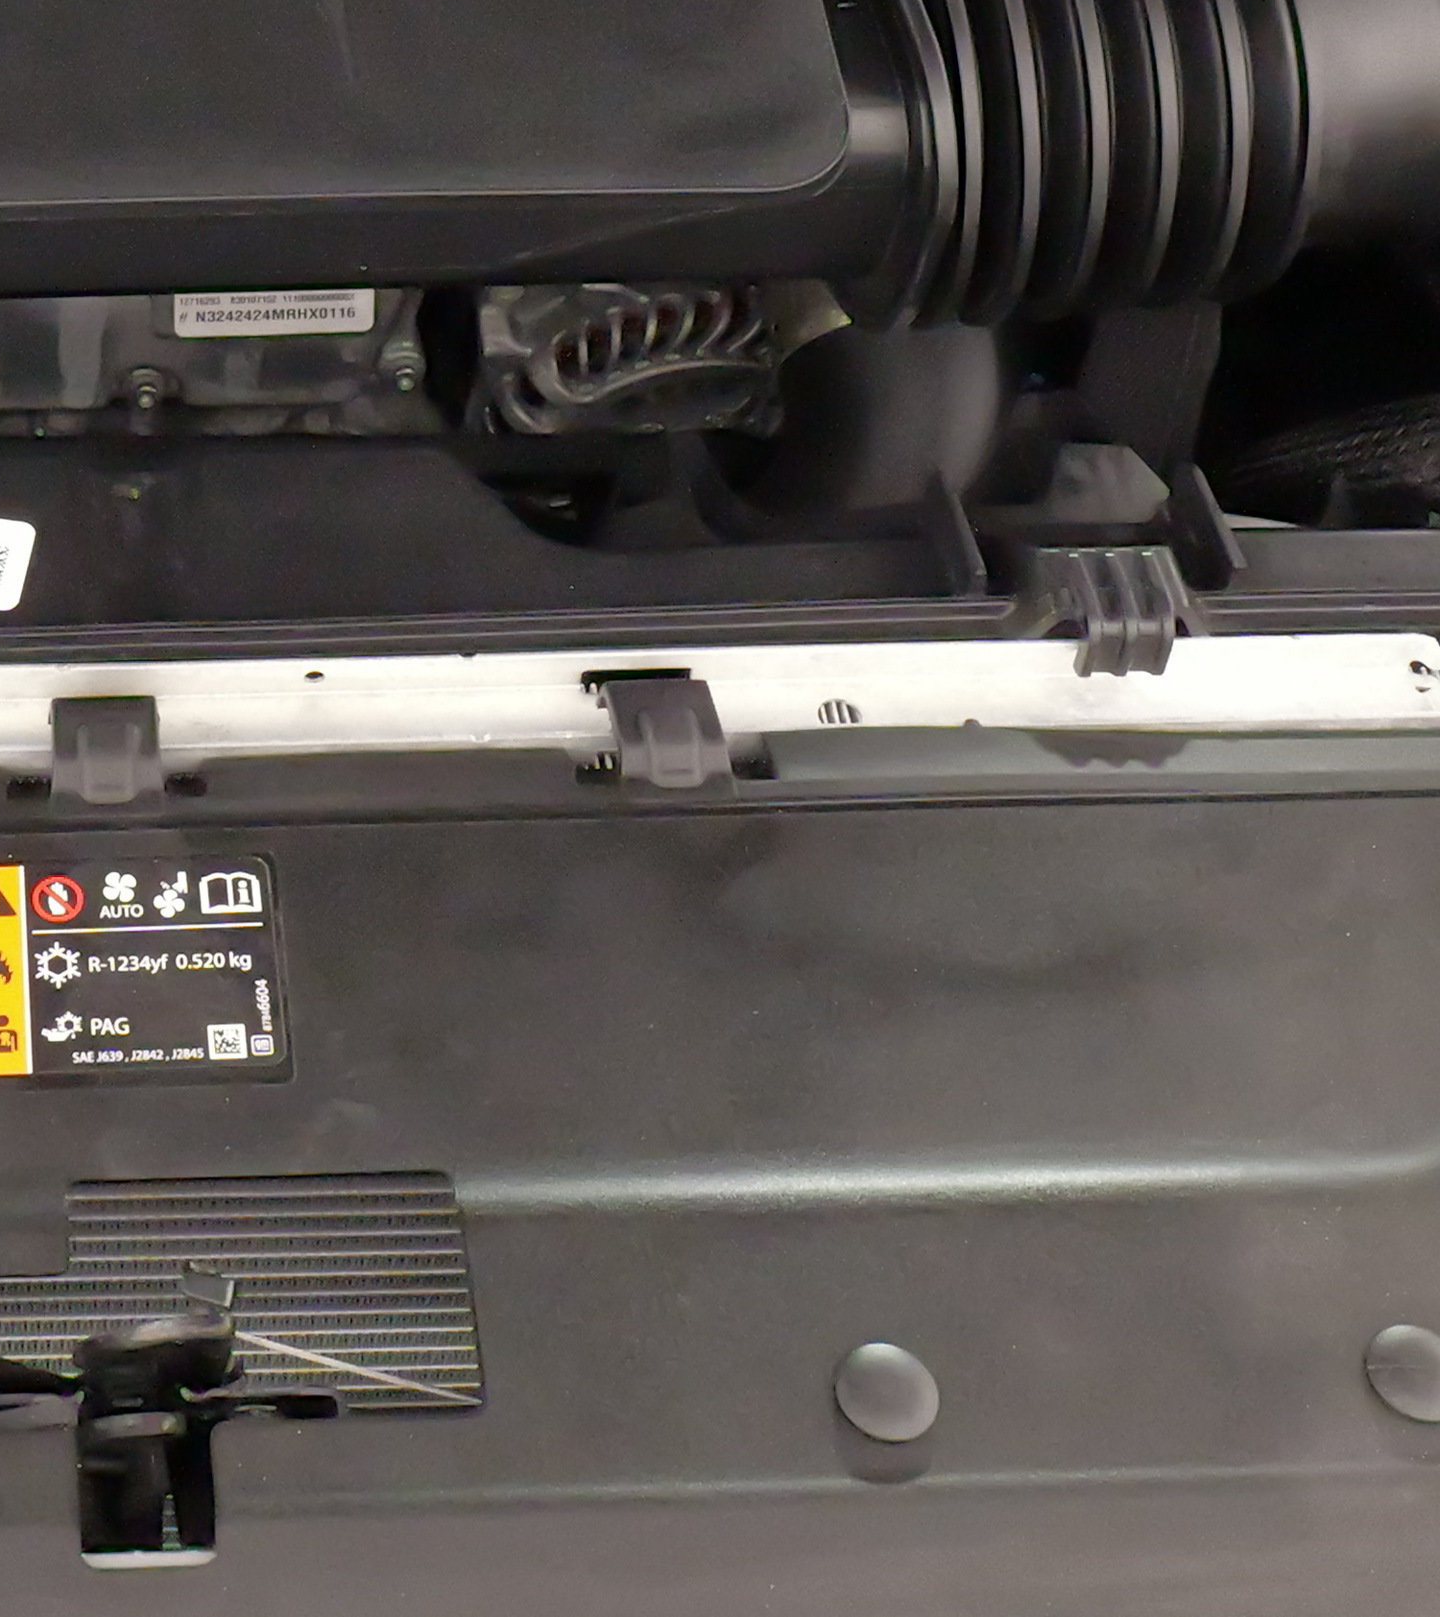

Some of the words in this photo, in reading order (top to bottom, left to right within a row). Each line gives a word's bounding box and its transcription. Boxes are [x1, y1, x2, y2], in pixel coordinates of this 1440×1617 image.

[99, 904, 144, 919] AUTO
[88, 953, 169, 972] R-1234yf
[175, 952, 226, 969] 0.520
[229, 951, 252, 971] kg
[90, 1017, 130, 1035] PAG
[72, 1050, 95, 1064] SAE
